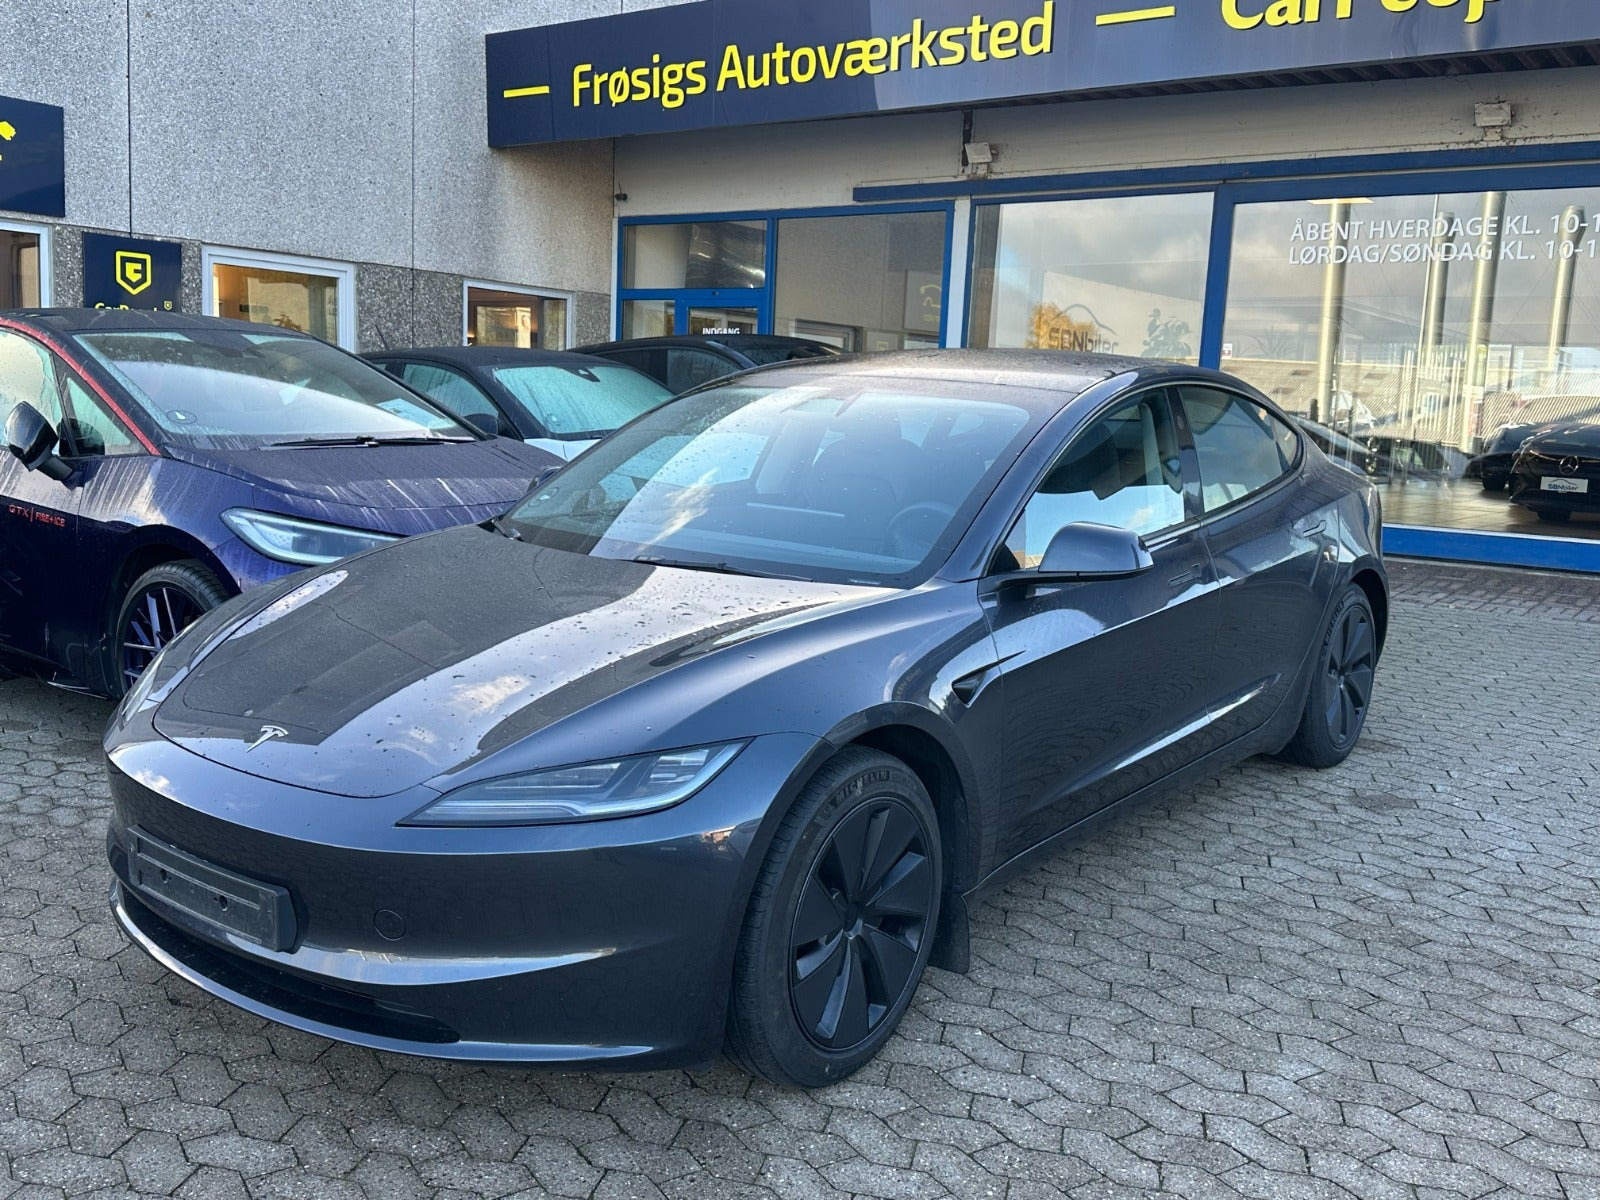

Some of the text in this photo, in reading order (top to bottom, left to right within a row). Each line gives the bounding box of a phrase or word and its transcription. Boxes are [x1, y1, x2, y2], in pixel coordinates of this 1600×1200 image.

[572, 54, 707, 109] Frøsigs
[716, 0, 1054, 93] Autoværksted
[1290, 218, 1365, 242] ÅBENT
[1369, 216, 1499, 240] HVERDAGE
[1505, 215, 1541, 235] KL.
[1288, 241, 1493, 265] LØRDAG/SØNDAG
[1500, 239, 1536, 260] KL.
[9, 504, 29, 517] GTX
